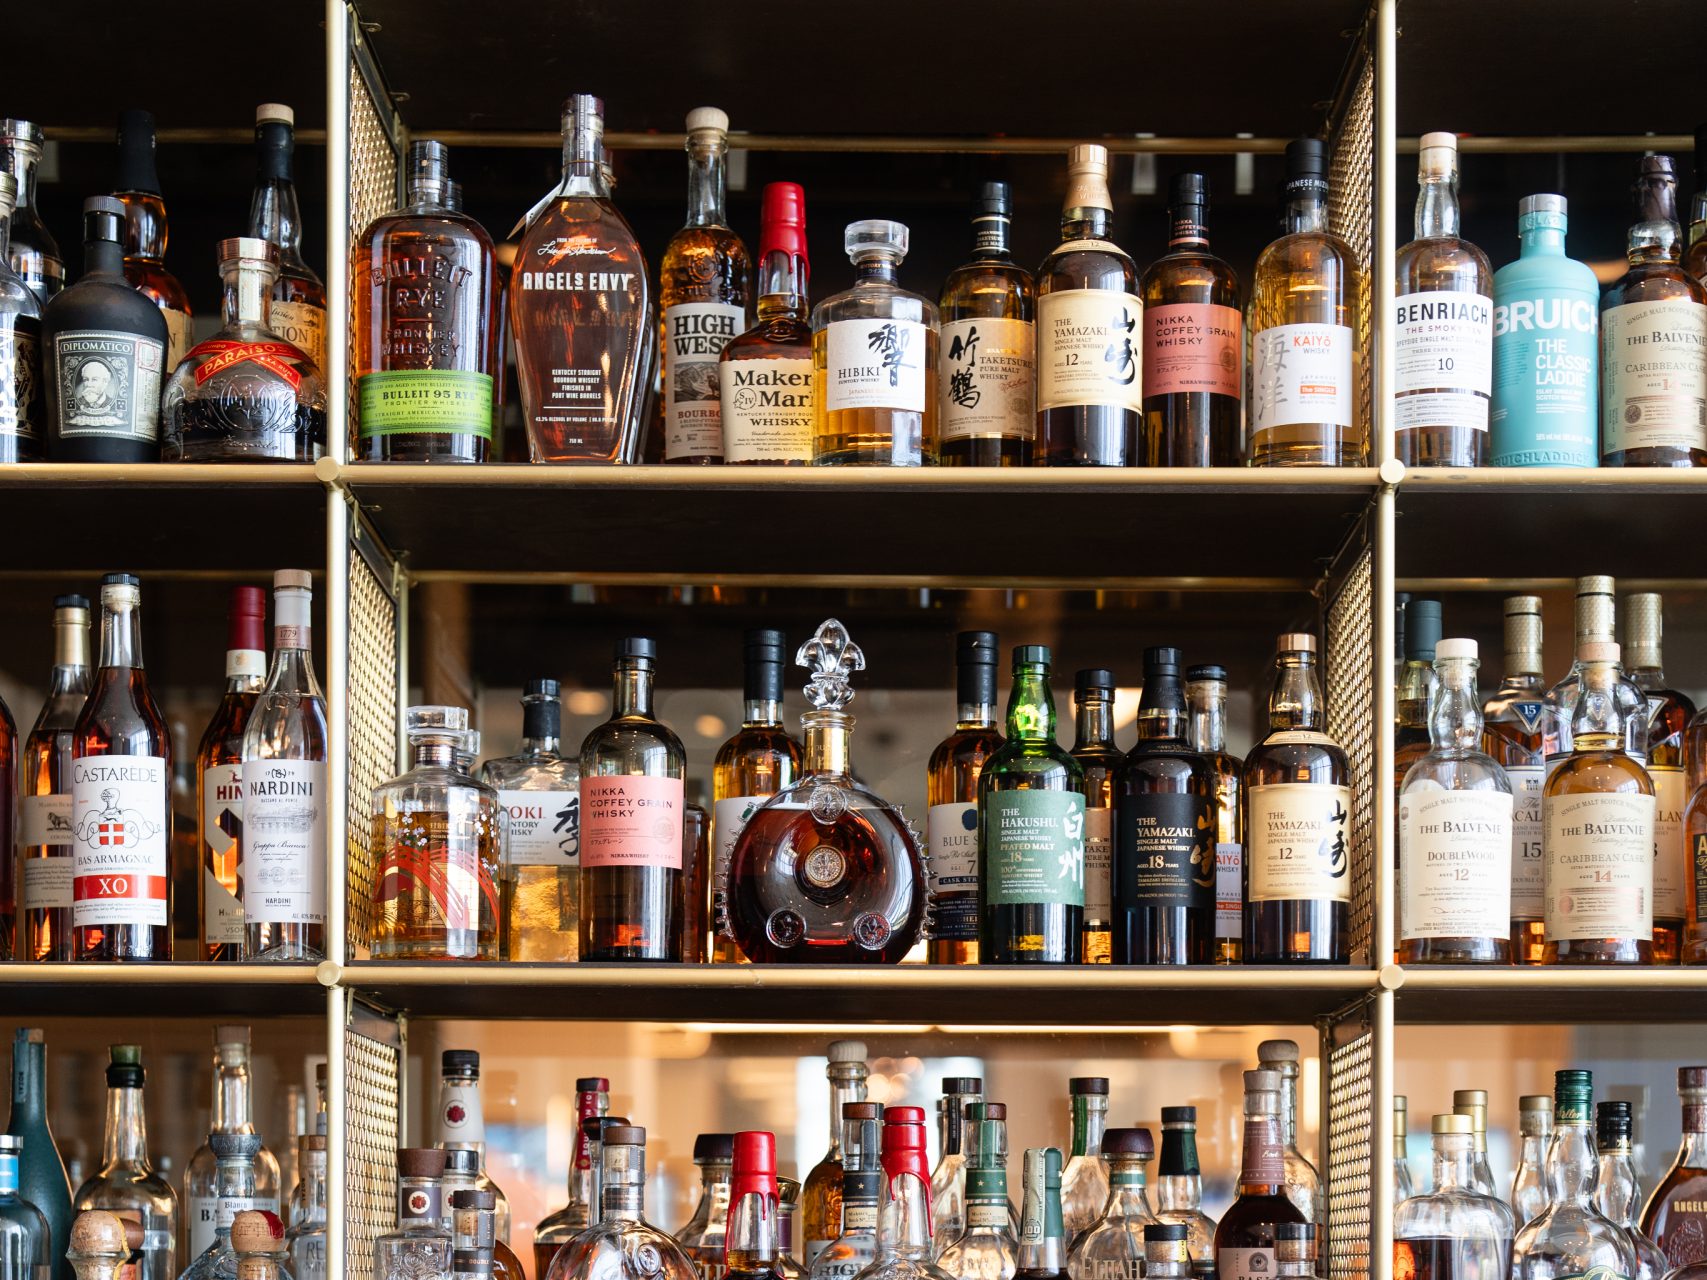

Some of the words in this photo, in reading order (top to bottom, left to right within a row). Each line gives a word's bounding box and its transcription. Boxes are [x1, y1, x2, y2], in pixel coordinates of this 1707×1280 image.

[372, 254, 473, 287] BULLEIT
[590, 273, 629, 291] ENVY
[396, 288, 445, 309] RYE
[1397, 303, 1488, 325] BENRIACH
[1627, 312, 1647, 326] SINGLE
[1650, 307, 1666, 315] MALT
[674, 314, 736, 336] HIGH
[1054, 318, 1072, 327] THE
[1156, 316, 1194, 327] NIKKA
[1054, 327, 1108, 338] YAMAZAKI
[1156, 327, 1202, 337] COFFEY
[1207, 328, 1236, 340] GRAIN
[1406, 326, 1424, 335] THE
[1156, 337, 1203, 348] WHISKY
[1536, 339, 1567, 354] THE
[1626, 335, 1649, 346] THE
[1066, 354, 1079, 366] 12
[1438, 358, 1454, 371] 10
[1536, 355, 1592, 373] CLASSIC
[838, 366, 880, 379] HIBIKI
[1626, 362, 1686, 373] CARIBBEAN
[1536, 370, 1586, 388] LADDIE
[383, 390, 429, 400] BULLEIT
[434, 390, 451, 398] 95
[455, 391, 475, 400] RYE
[750, 418, 811, 426] WHISKY
[280, 630, 297, 638] 1779
[1524, 705, 1537, 715] 15
[74, 764, 157, 784] CASTARÈDE
[251, 782, 313, 797] NARDINI
[591, 788, 625, 797] NIKKA
[590, 799, 633, 808] COFFEY
[1420, 802, 1439, 813] SINGLE
[1521, 797, 1540, 809] The
[1561, 803, 1580, 816] SINGLE
[1582, 800, 1599, 810] MALT
[1600, 798, 1624, 806] SCOTCH
[506, 806, 543, 820] OKI
[592, 810, 635, 818] WHISKY
[1002, 808, 1020, 816] THE
[1268, 812, 1286, 820] THE
[1137, 818, 1157, 826] THE
[1268, 822, 1321, 831] YAMAZAKI
[1137, 828, 1194, 838] YAMAZAKI
[1420, 825, 1440, 834] THE
[1443, 822, 1502, 835] BALVENIE
[1561, 827, 1581, 837] THE
[1584, 824, 1645, 835] BALVENIE
[943, 836, 968, 847] BLUE
[1279, 848, 1293, 860] 12
[1428, 850, 1495, 862] DOUBLEWOOD
[1522, 842, 1542, 858] 15
[78, 855, 92, 865] BAS
[94, 854, 153, 865] ARMAGNAC
[1010, 852, 1022, 863] 18
[1149, 856, 1165, 869] 18
[1560, 854, 1620, 864] CARIBBEAN
[1623, 854, 1645, 863] CASK
[967, 860, 976, 874] 7
[1454, 869, 1469, 881] 12
[1594, 870, 1612, 883] 14
[99, 878, 128, 895] XO
[1081, 1257, 1143, 1280] ELIJAH
